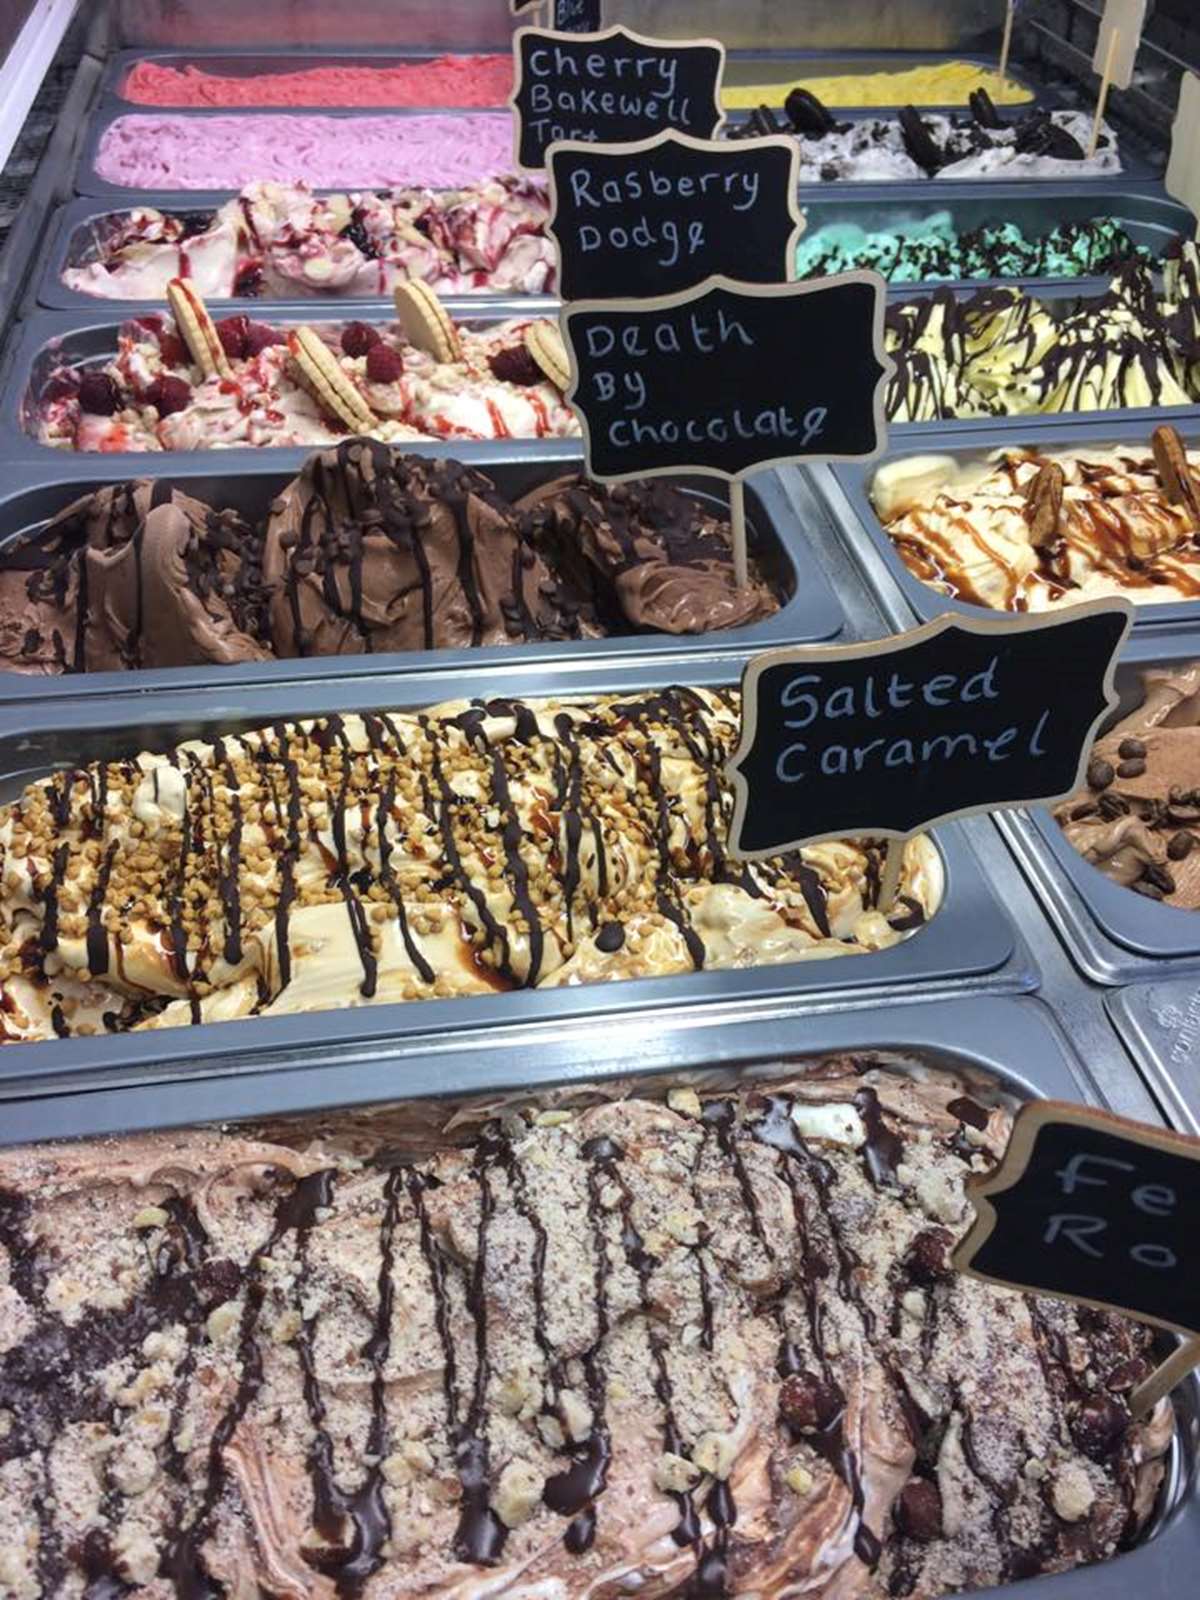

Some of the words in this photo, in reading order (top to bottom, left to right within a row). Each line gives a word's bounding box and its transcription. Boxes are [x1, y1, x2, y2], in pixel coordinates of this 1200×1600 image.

[529, 47, 678, 99] Cherry
[530, 83, 691, 125] Bakewell
[529, 117, 599, 142] Tart
[570, 168, 759, 211] Rasberry
[578, 215, 705, 266] Dodge
[585, 309, 755, 357] Death
[592, 371, 647, 411] By
[780, 655, 1000, 729] Salted
